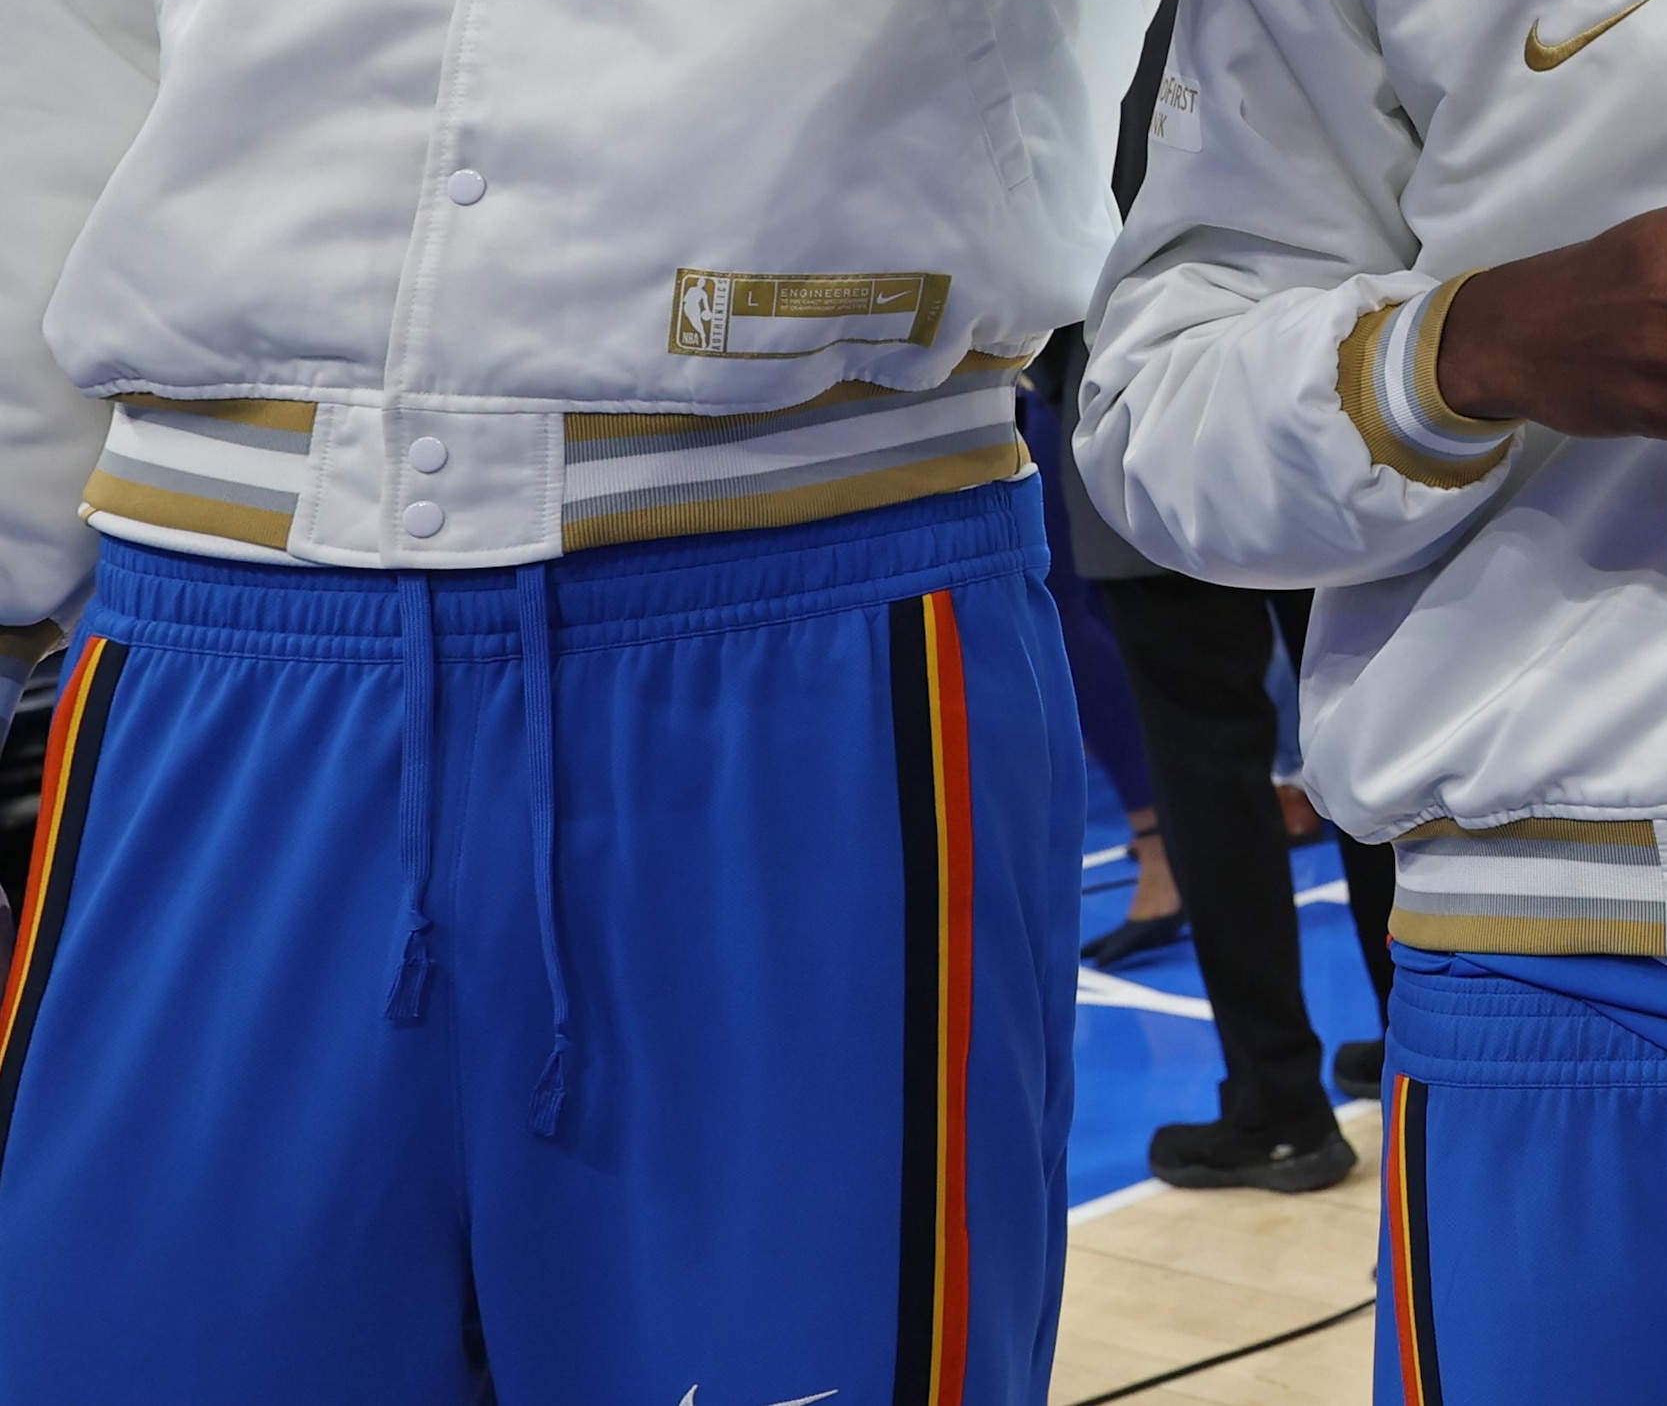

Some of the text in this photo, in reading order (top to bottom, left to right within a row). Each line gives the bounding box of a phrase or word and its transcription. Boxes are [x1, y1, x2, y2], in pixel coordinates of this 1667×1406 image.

[747, 290, 759, 307] L
[780, 287, 869, 298] ENGINEERED
[711, 279, 728, 351] AUTHENTICS
[681, 331, 700, 346] NBA
